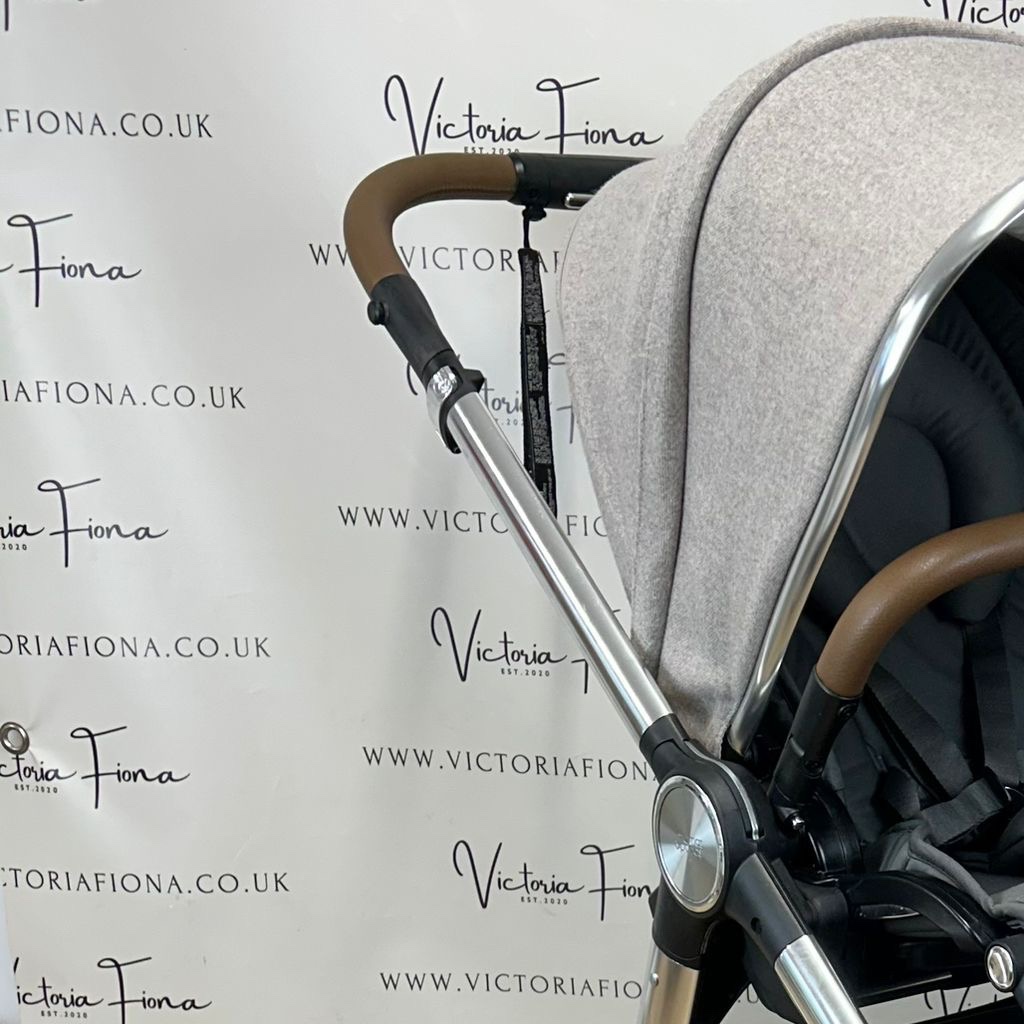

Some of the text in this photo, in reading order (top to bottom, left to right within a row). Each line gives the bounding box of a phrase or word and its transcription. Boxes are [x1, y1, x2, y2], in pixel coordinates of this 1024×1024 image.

[384, 74, 664, 156] Victoria Fiona
[7, 213, 142, 307] Fiona
[37, 477, 169, 568] Fiona
[430, 607, 568, 682] Victoria
[501, 668, 550, 677] EST.2020
[70, 726, 190, 809] Fiona
[362, 746, 657, 781] WWW.VICTORIAFION
[1, 867, 290, 894] TORIAFIONA.CO.UK
[453, 840, 585, 909] Victoria
[520, 896, 568, 904] EST.2020
[13, 957, 104, 1009] ictoria
[41, 1010, 88, 1018] EST.2020
